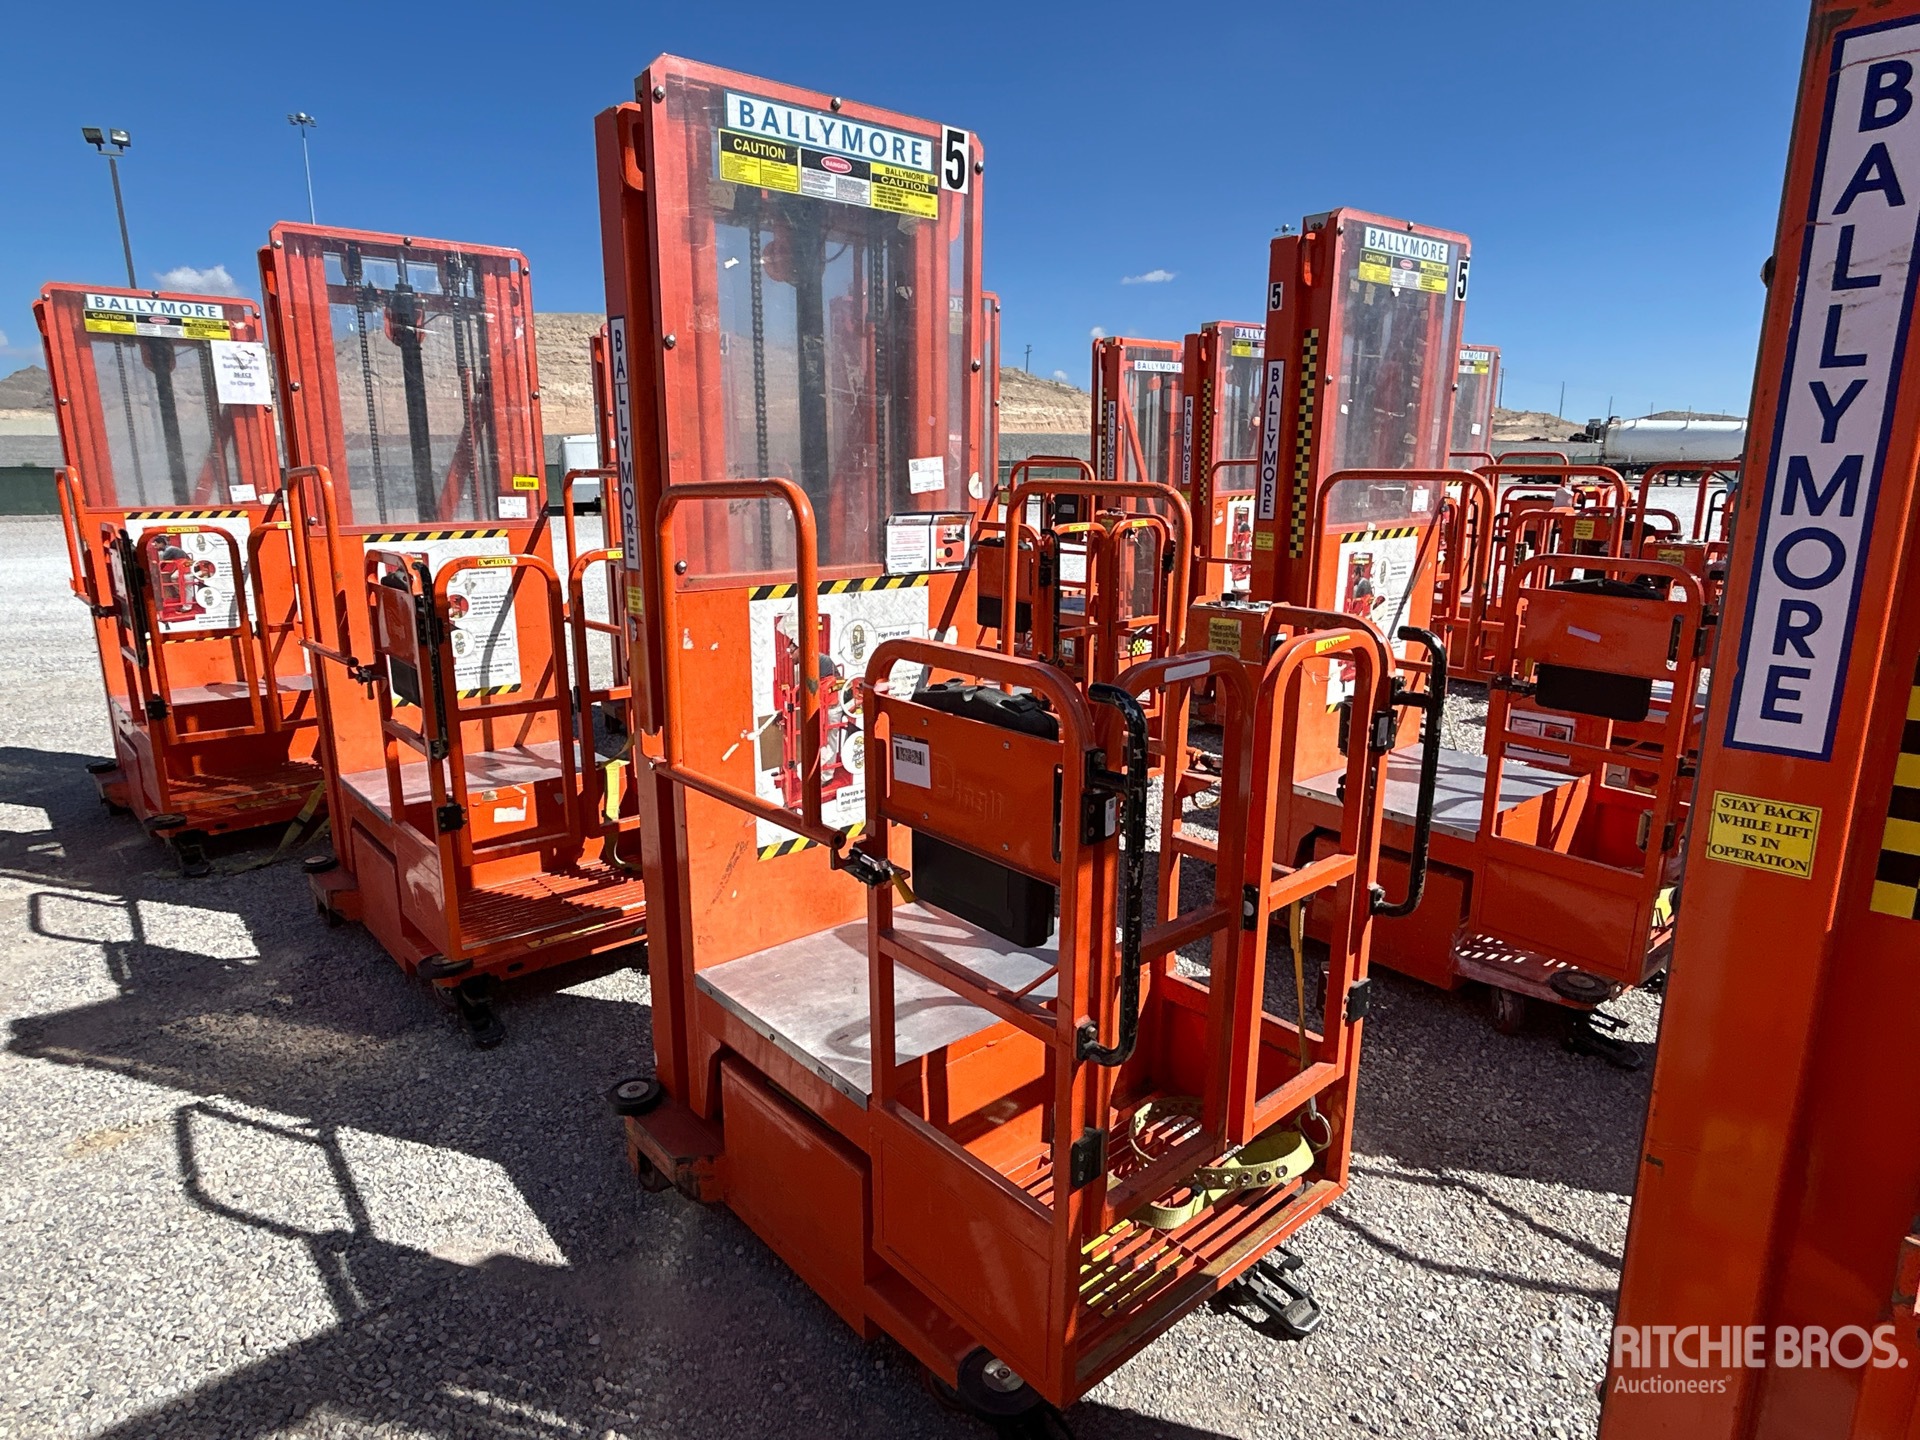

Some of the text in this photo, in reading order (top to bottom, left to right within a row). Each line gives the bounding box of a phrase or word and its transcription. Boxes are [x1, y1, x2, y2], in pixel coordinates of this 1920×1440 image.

[738, 99, 923, 167] BALLYMORE
[733, 137, 787, 161] CAUTION
[945, 128, 966, 190] 5
[880, 176, 930, 192] CAUTION
[885, 167, 925, 182] BALLYMORE
[1364, 253, 1388, 264] CAUTION
[1369, 229, 1445, 261] BALLYMORE
[1457, 261, 1469, 300] 5
[94, 296, 218, 318] BALLYMORE
[1271, 283, 1282, 310] 5
[92, 312, 127, 321] CAUTION
[1136, 361, 1180, 372] BALLYMORE
[1760, 59, 1915, 725] BALLYMORE
[614, 329, 636, 560] BALLYMORE
[1107, 403, 1115, 477] BALLYMORE
[1183, 399, 1192, 481] BALLYMORE
[1262, 367, 1280, 513] BALLYMORE
[1720, 797, 1813, 823] STAY BACK
[1716, 812, 1813, 840] WHILE LIFT
[1741, 833, 1781, 851] IS IN
[1711, 843, 1809, 872] OPERATION
